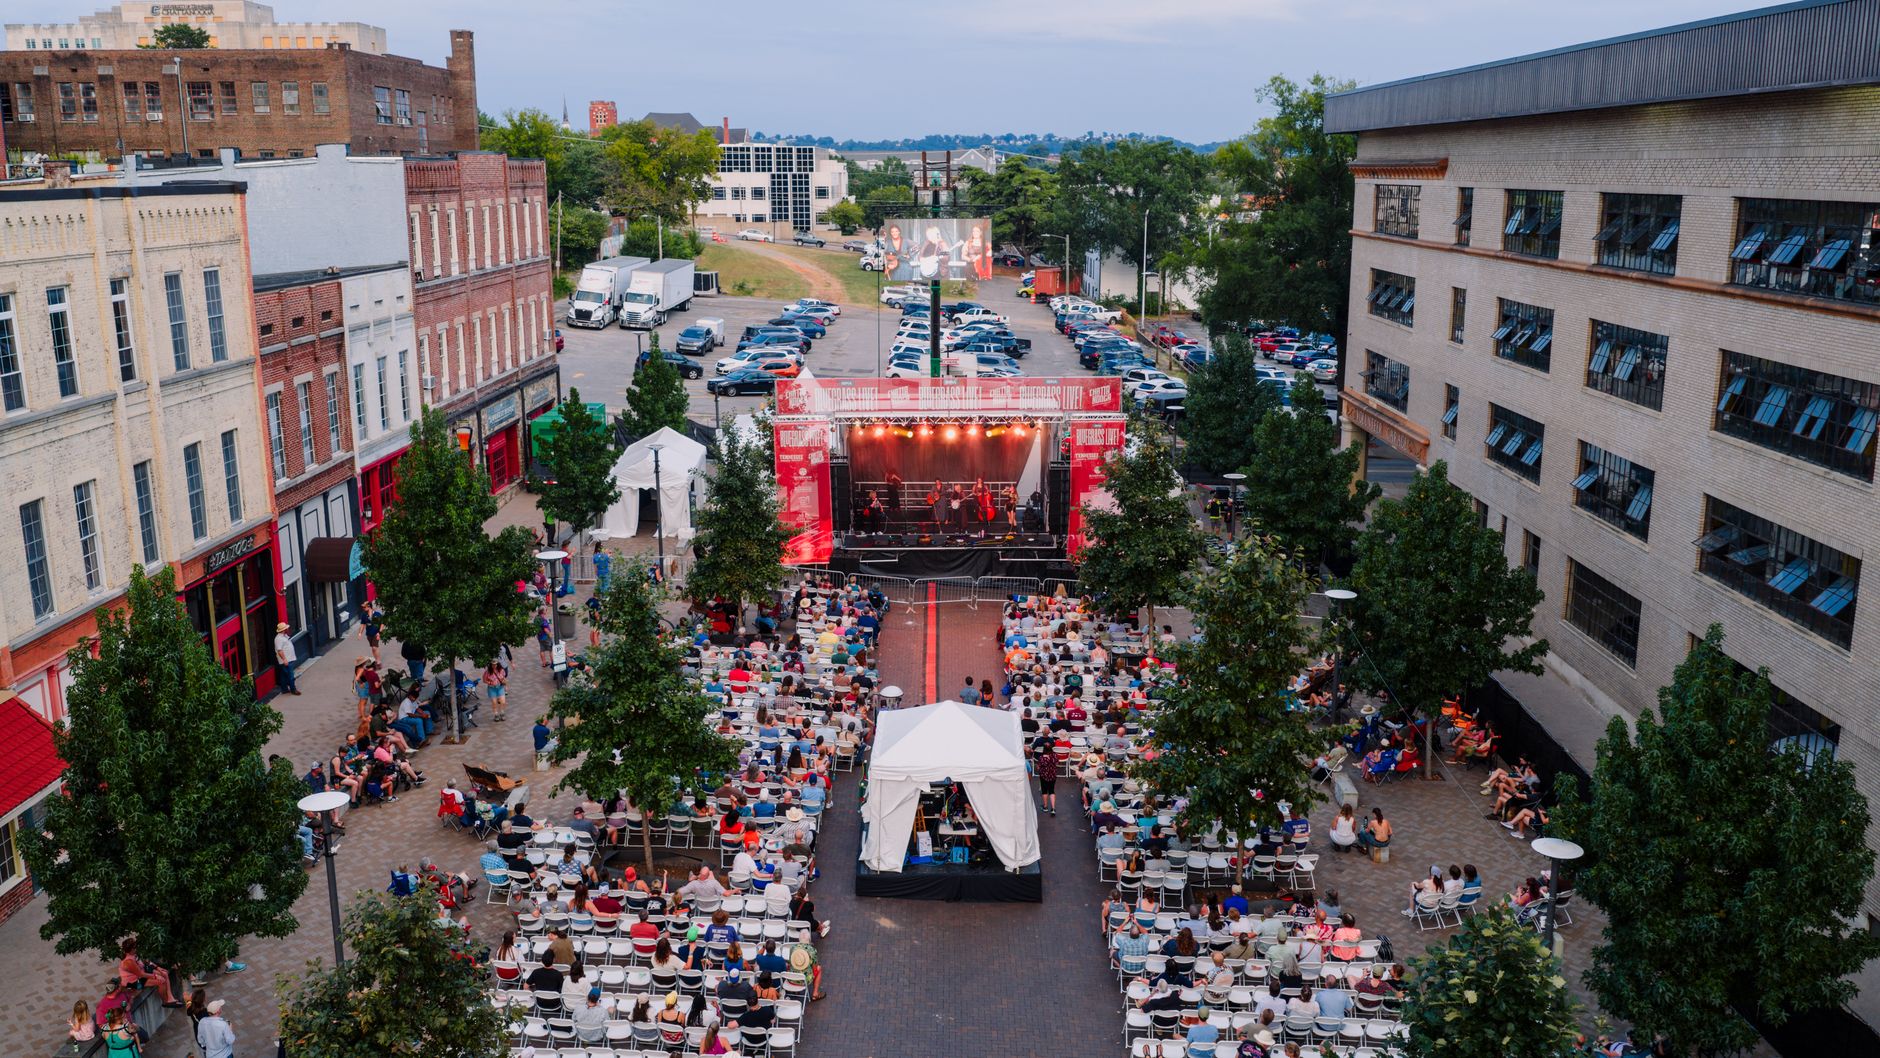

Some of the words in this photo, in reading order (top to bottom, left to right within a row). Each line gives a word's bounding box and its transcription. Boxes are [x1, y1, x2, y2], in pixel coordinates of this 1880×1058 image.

[919, 386, 961, 409] BLUEGRASS
[962, 386, 982, 409] LIVE!
[1020, 386, 1061, 409] BLUEGRASS
[1062, 385, 1083, 409] LIVE!
[780, 430, 808, 447] BLUEGRASS
[1076, 428, 1104, 446] BLUEGRASS
[1105, 428, 1119, 445] LIVE!
[215, 538, 248, 567] TATTOO
